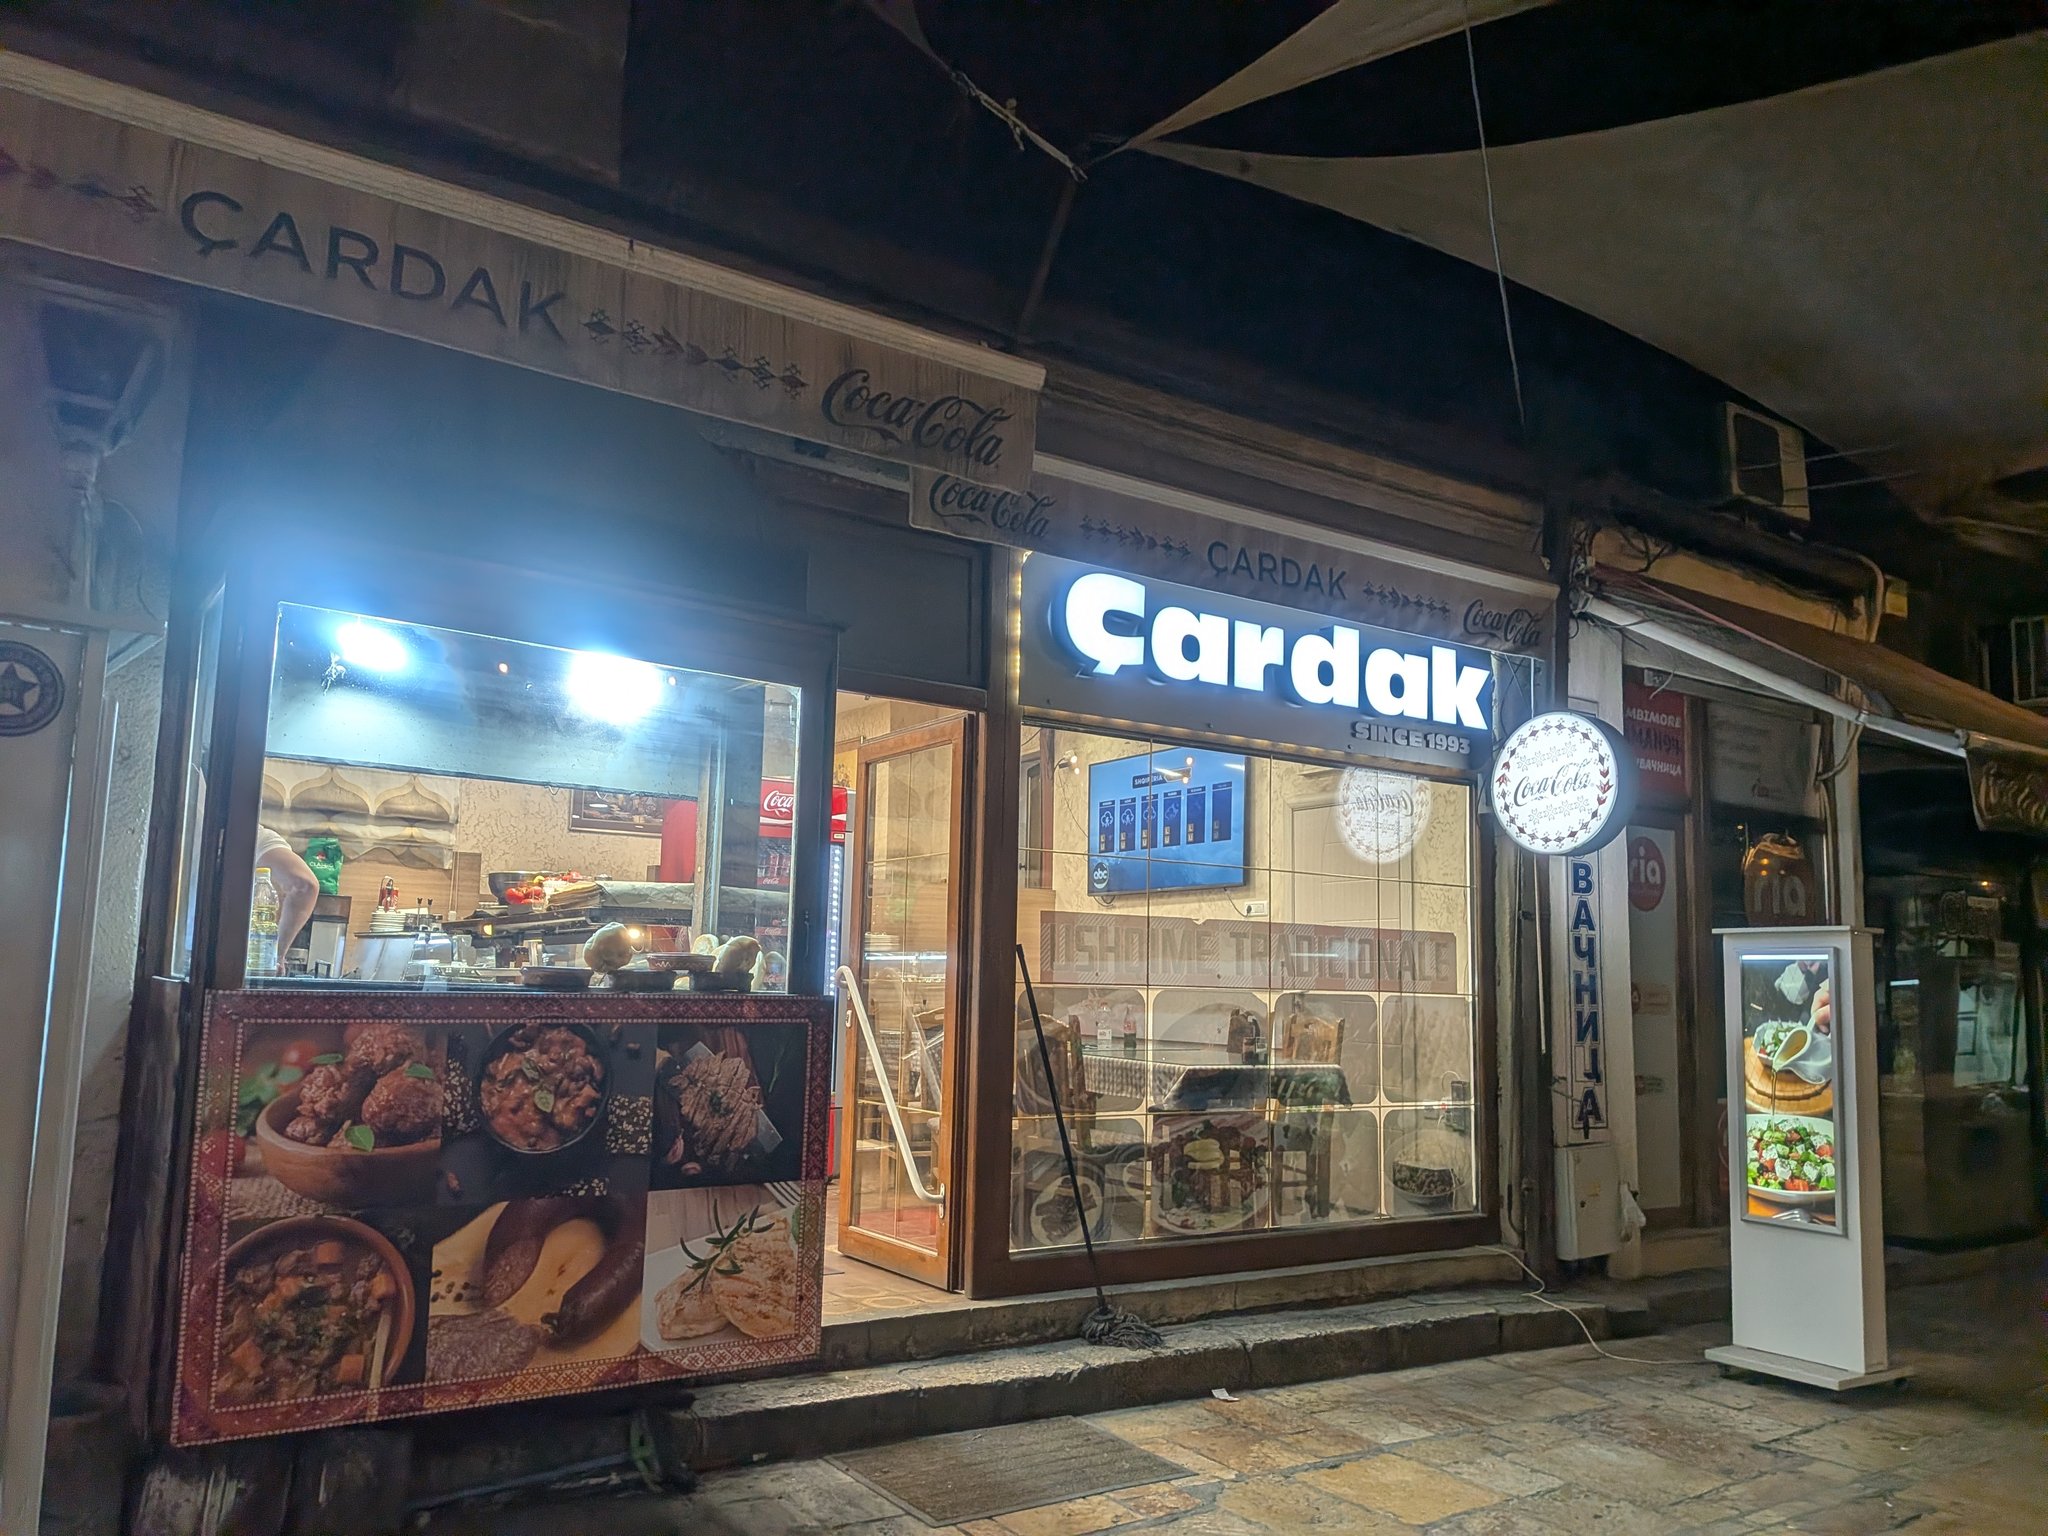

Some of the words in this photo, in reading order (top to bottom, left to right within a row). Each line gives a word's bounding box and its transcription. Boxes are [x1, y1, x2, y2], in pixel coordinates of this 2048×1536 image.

[180, 190, 569, 344] ÇARDAK
[1206, 540, 1348, 600] ÇARDAK
[1064, 572, 1491, 731] Çardak
[1351, 720, 1424, 748] SINCE
[1425, 732, 1471, 754] 1993
[1571, 855, 1604, 1123] ВАЧНИЦА
